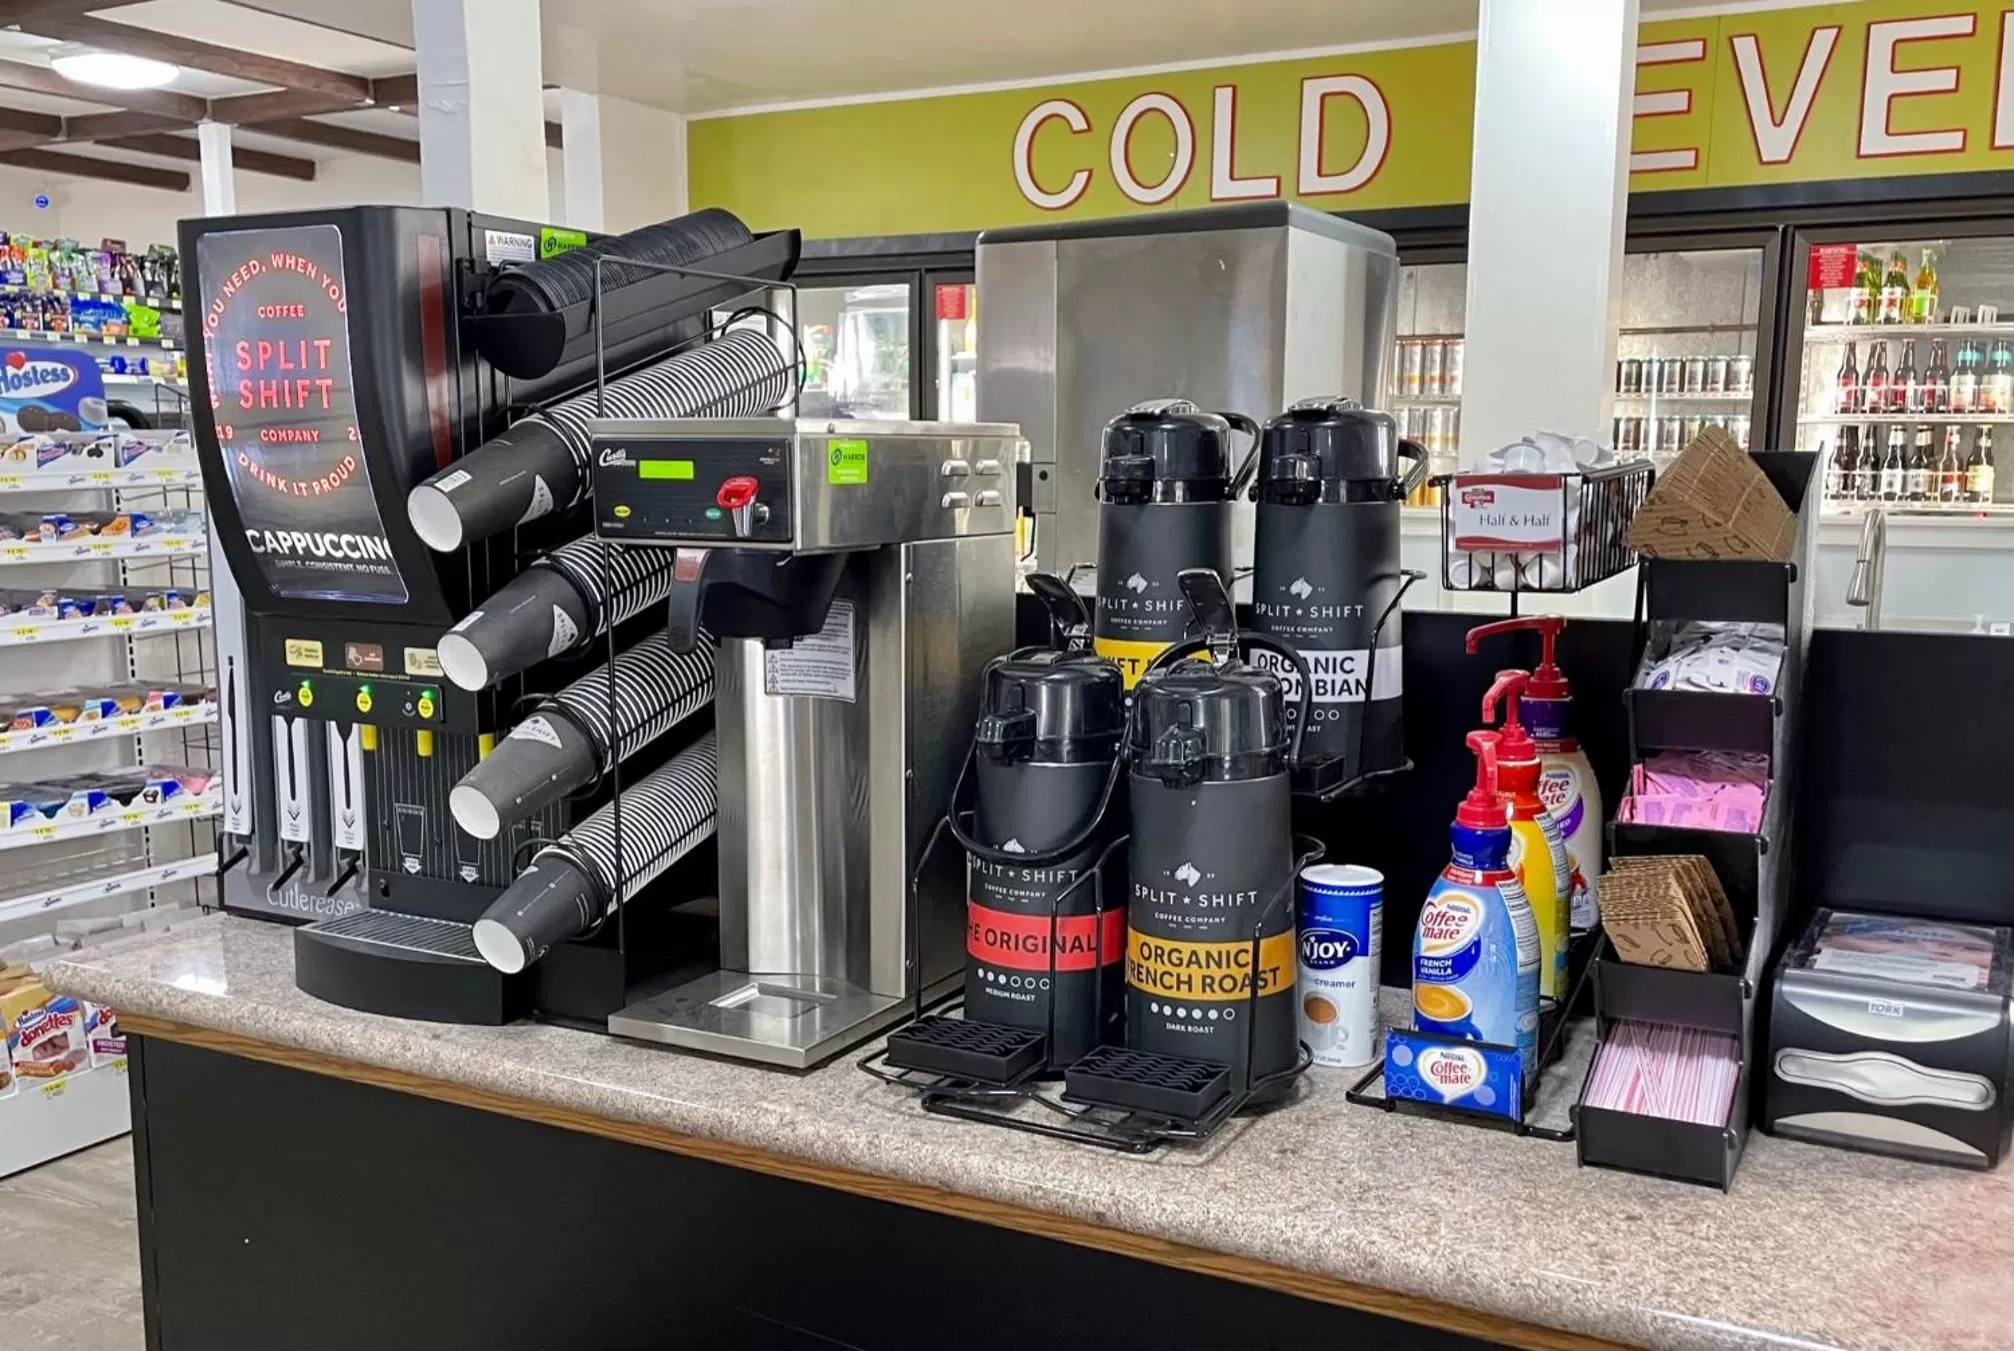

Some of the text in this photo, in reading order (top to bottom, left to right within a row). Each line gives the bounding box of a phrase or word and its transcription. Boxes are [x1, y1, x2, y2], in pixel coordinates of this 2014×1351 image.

[1012, 9, 2014, 210] COLD EVE
[497, 234, 533, 249] WARNING
[202, 252, 346, 339] YOU NEED, WHEN YOU
[257, 304, 305, 319] COFFEE
[235, 339, 332, 371] SPLIT
[238, 378, 333, 409] SHIFT
[260, 428, 320, 443] COMPANY
[599, 448, 627, 467] Curtis
[238, 453, 357, 497] DRINK IT PROUD
[1479, 513, 1552, 527] Half & Half
[1144, 599, 1184, 612] SHIF
[1255, 602, 1365, 619] SPLIT SHIFT
[1110, 616, 1168, 626] COFFEE COMPANY
[1271, 624, 1334, 634] COFFEE COMPANY
[1021, 868, 1079, 884] SHIFT
[985, 882, 1047, 898] COFFEE COMPANY
[1135, 883, 1258, 908] SPLIT SHIFT
[1154, 911, 1227, 924] COFFEE COMPANY
[1421, 900, 1469, 928] Coffee
[984, 926, 1097, 955] ORIGINAL
[1422, 926, 1460, 940] mate
[1139, 940, 1251, 970] ORGANIC
[1420, 957, 1452, 968] FRENCH
[1420, 966, 1453, 976] VANILLA
[1201, 965, 1281, 995] ROAST
[1314, 977, 1356, 989] creamer
[1010, 991, 1036, 1002] ROAST
[1870, 1003, 1901, 1015] TORK
[20, 1013, 74, 1047] donettes
[1165, 1022, 1215, 1035] DARK ROAST
[1430, 1060, 1468, 1077] Coffee
